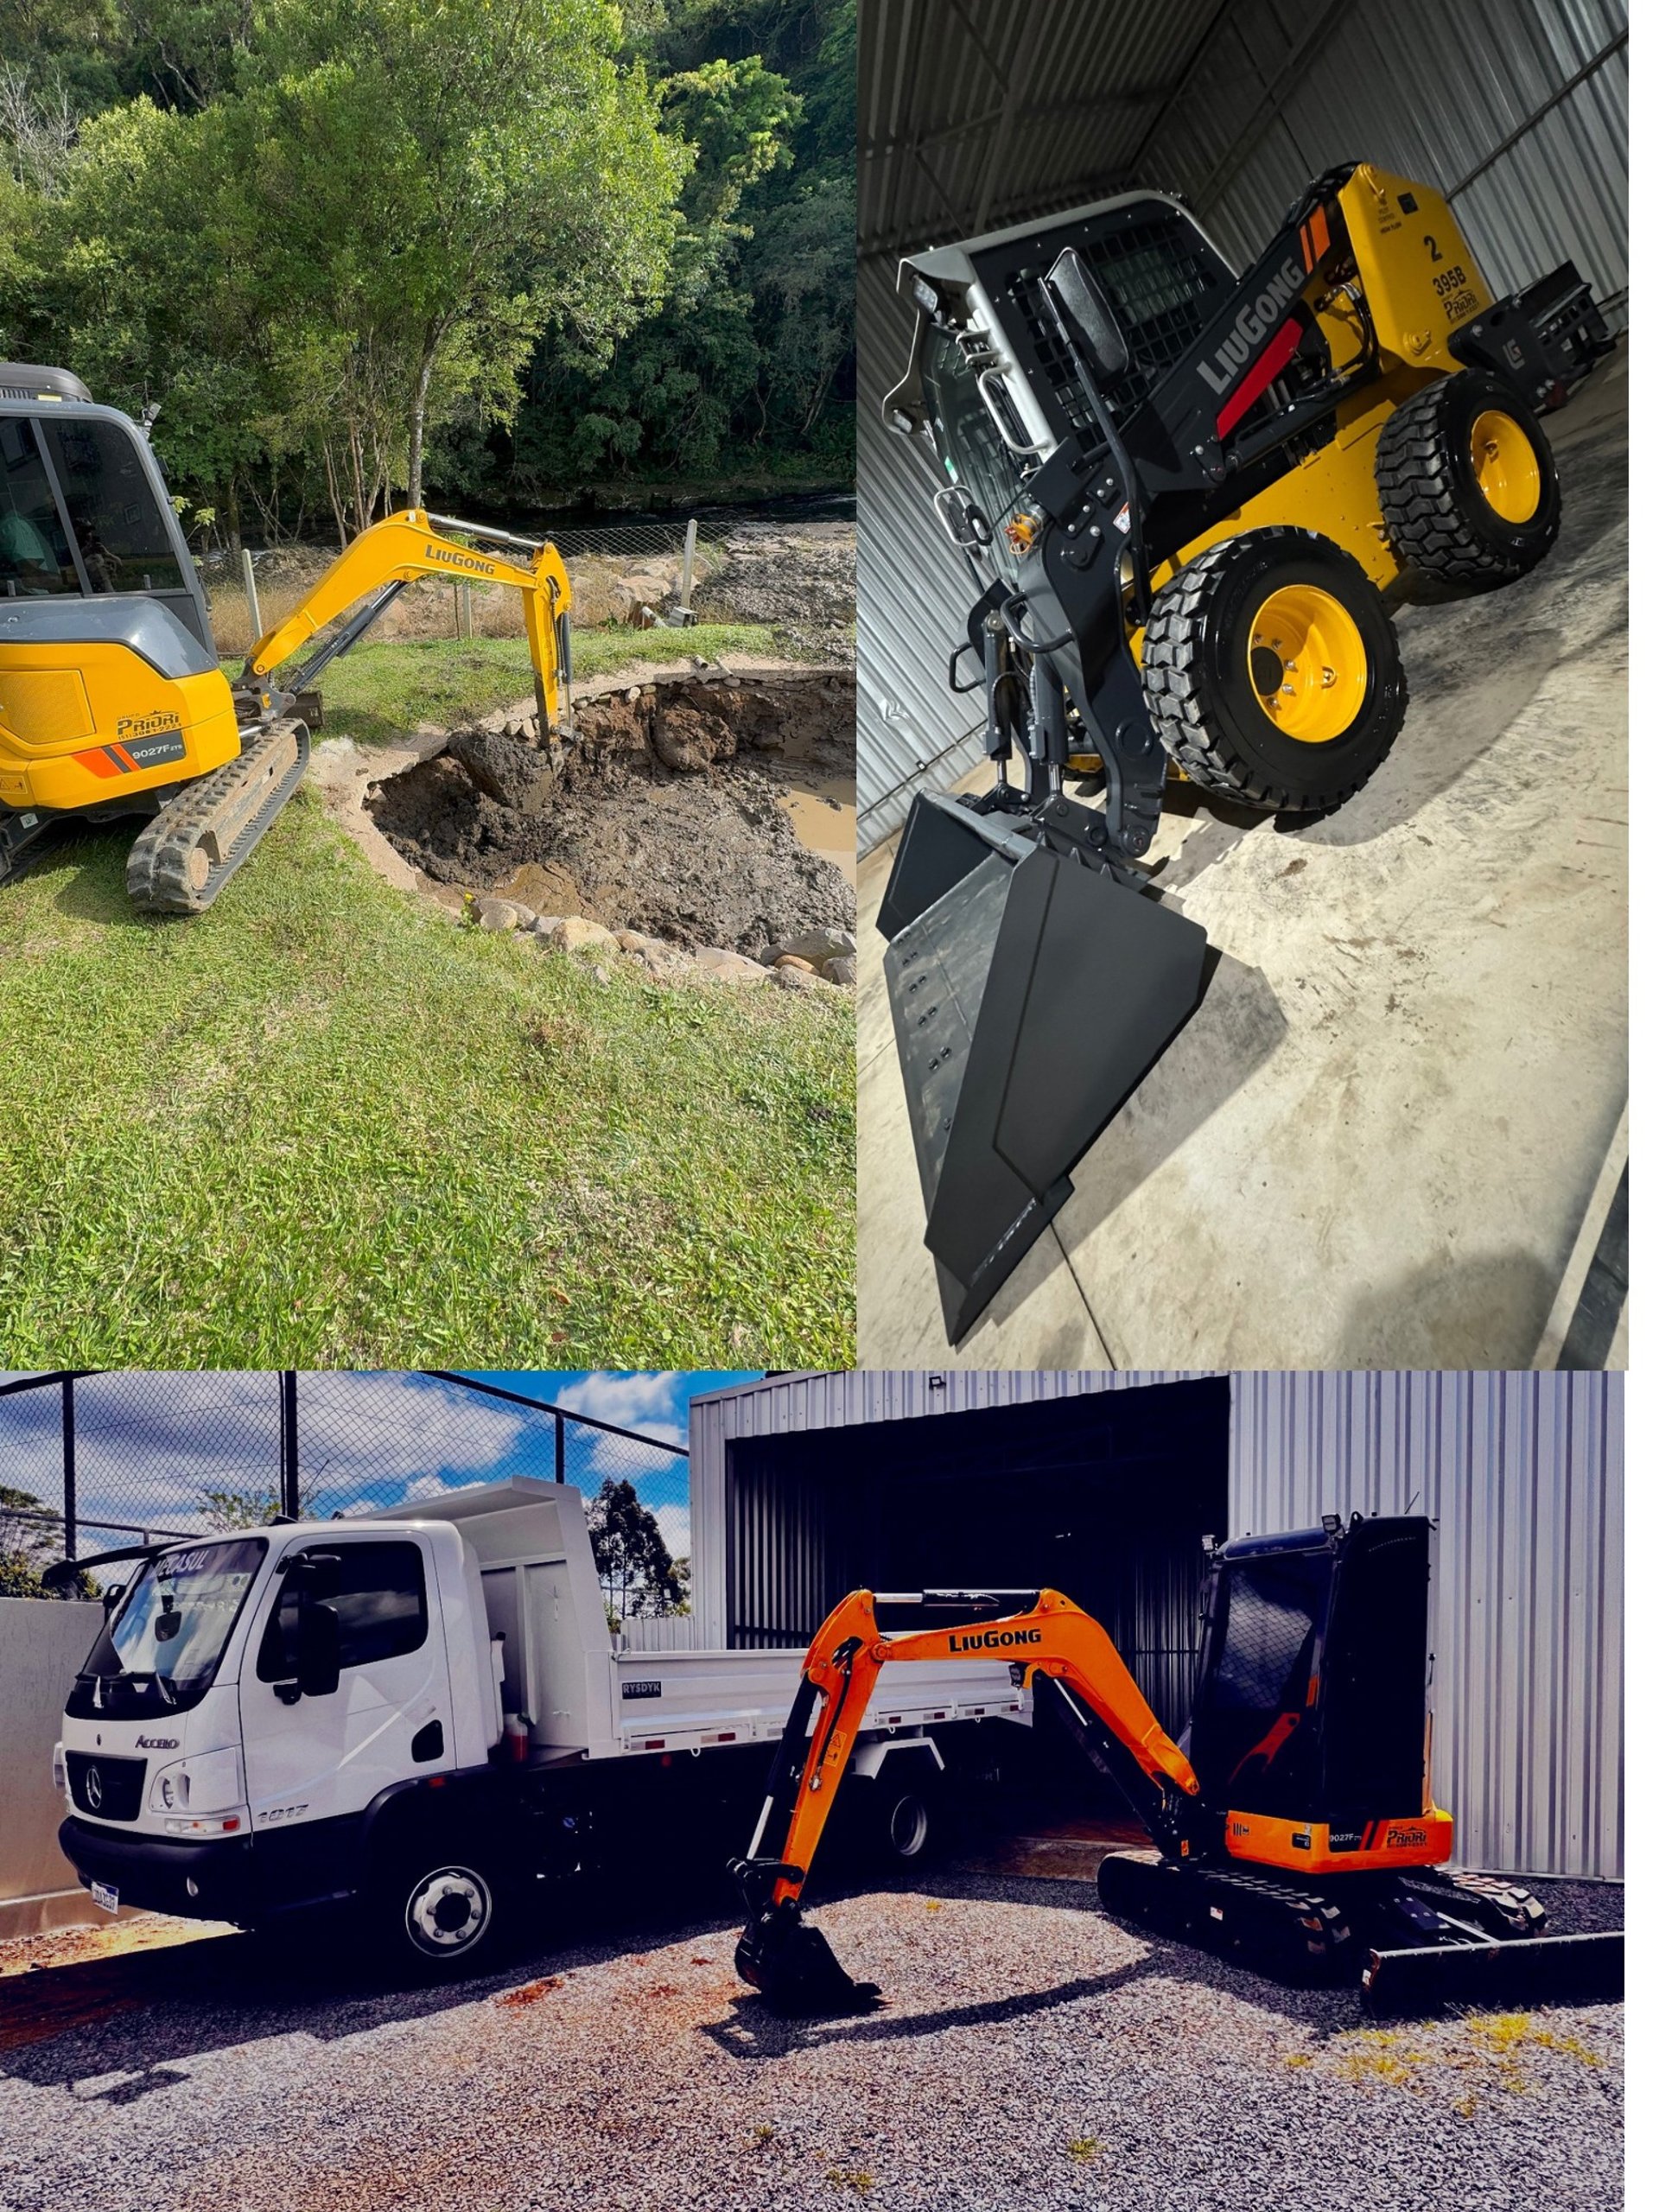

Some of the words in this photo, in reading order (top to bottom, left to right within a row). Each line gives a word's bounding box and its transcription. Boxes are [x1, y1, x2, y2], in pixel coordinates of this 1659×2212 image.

[1423, 235, 1443, 262] 2
[1433, 265, 1467, 296] 395B
[1196, 257, 1306, 395] LIUGONG
[425, 544, 496, 575] LIUGONG
[132, 744, 170, 760] 9027F
[949, 1629, 1041, 1652] LIUGONG
[622, 1682, 660, 1694] RYSDYK
